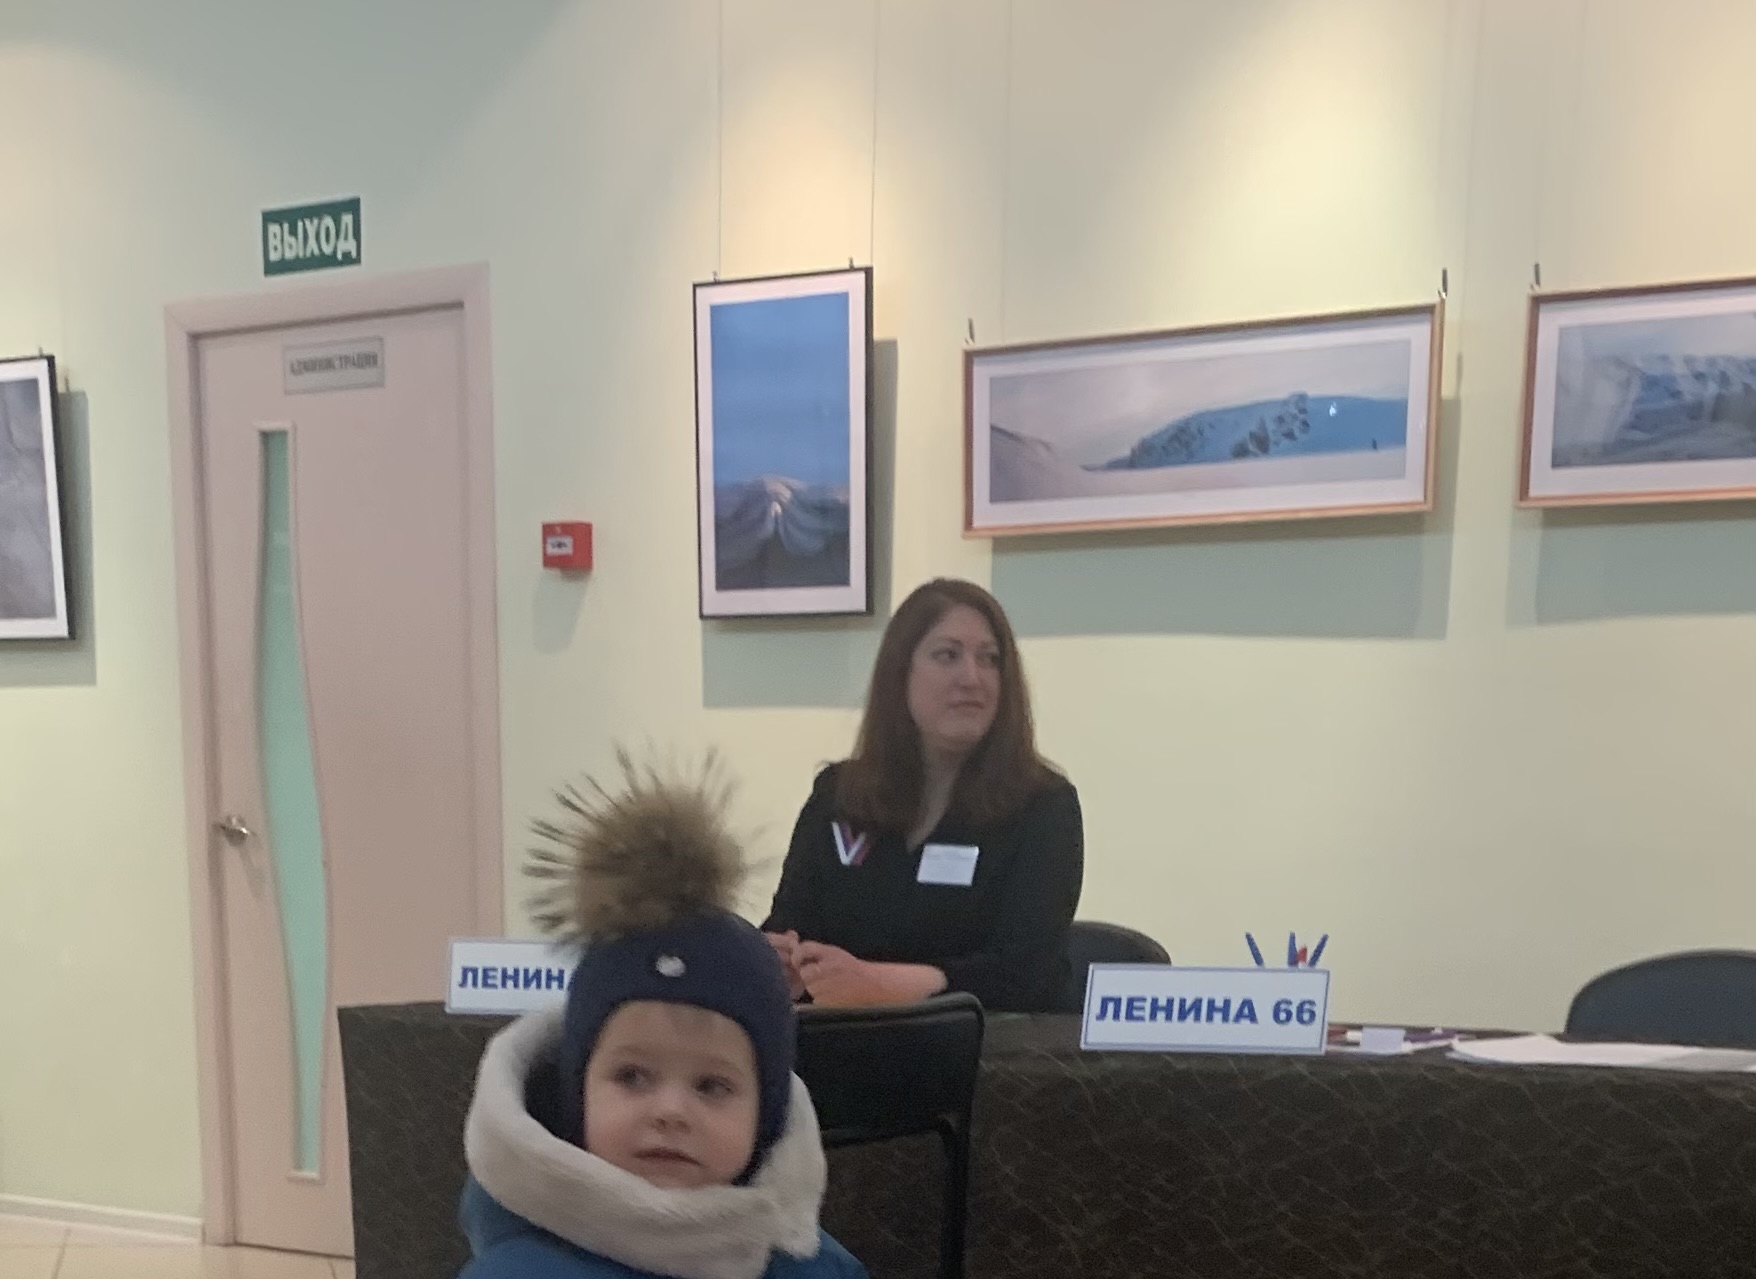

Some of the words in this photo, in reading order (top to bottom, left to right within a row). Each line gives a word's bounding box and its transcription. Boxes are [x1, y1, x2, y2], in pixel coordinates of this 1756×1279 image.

[267, 212, 357, 262] ВЫХОД
[458, 966, 573, 990] ЛЕНИН
[1095, 995, 1259, 1025] ЛЕНИНА
[1271, 999, 1317, 1026] 66
